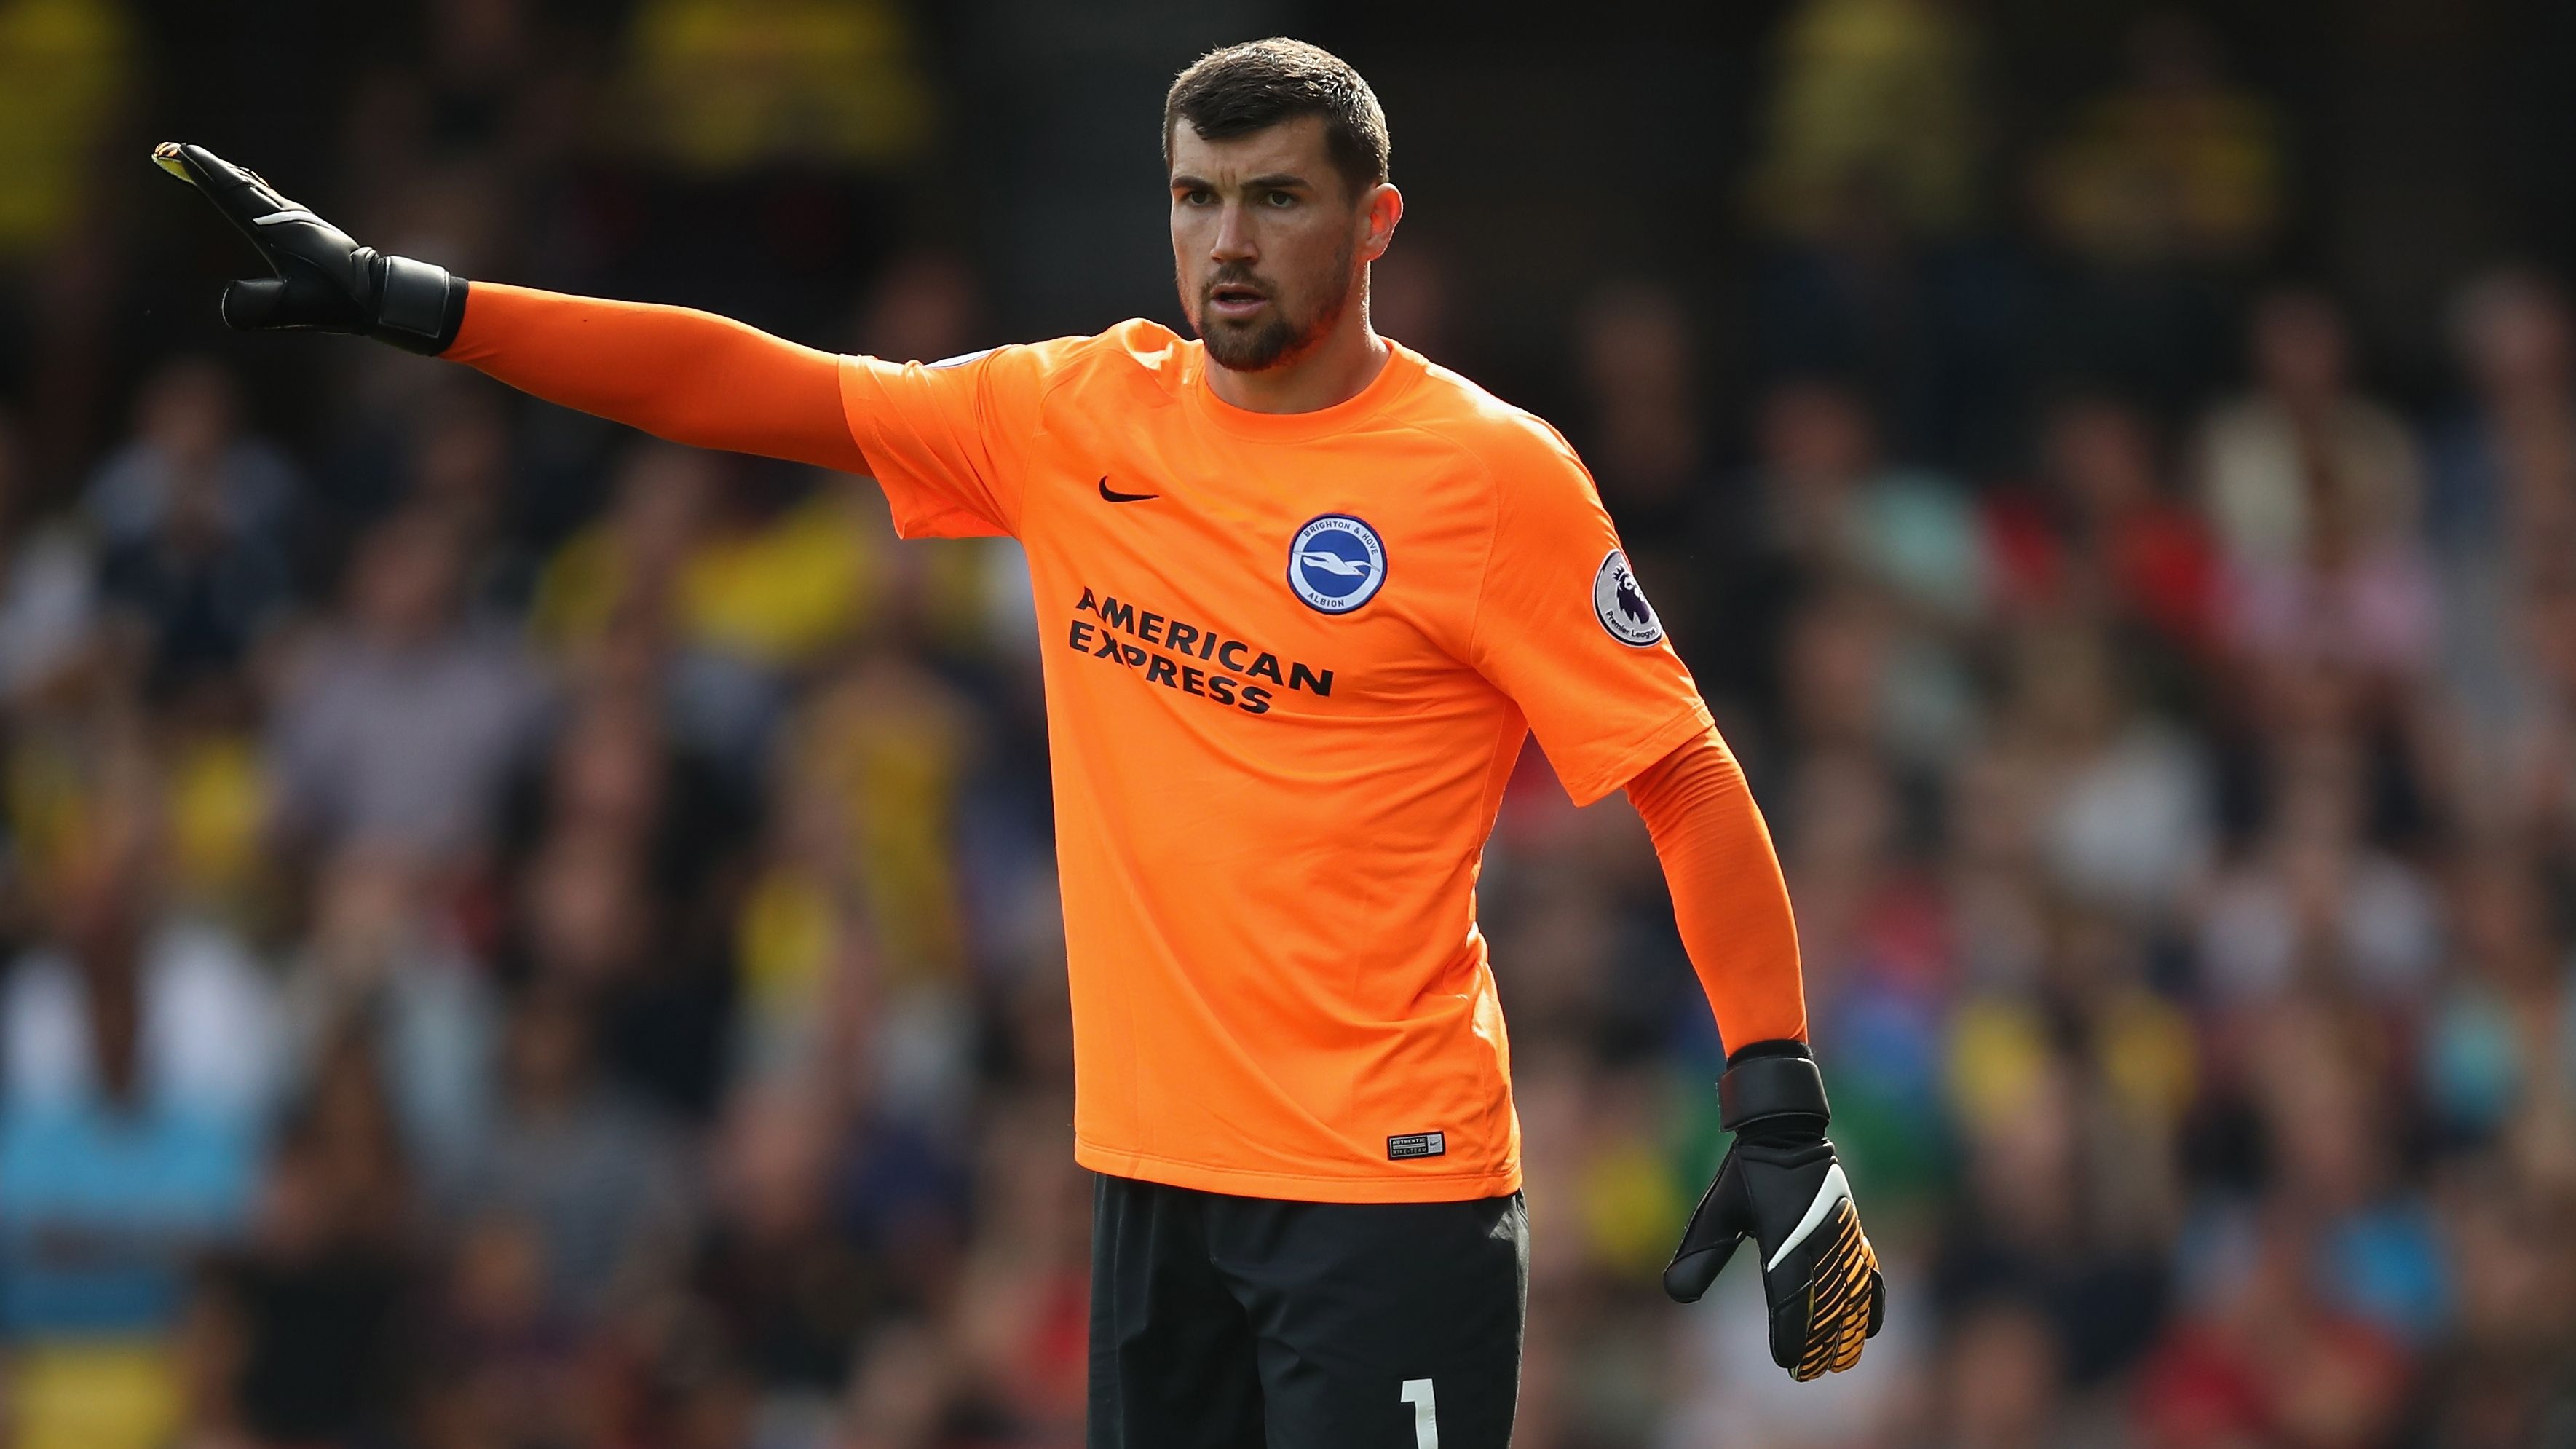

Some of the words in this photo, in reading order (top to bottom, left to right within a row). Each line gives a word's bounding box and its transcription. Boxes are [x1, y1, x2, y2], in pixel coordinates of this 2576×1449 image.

[1303, 521, 1351, 537] BRIGHTON
[1354, 526, 1360, 534] &
[1362, 533, 1378, 555] HOVE
[1307, 592, 1345, 607] ALBION
[1605, 610, 1630, 635] Premier
[1069, 620, 1273, 714] EXPRESS
[1075, 586, 1334, 697] AMERICAN
[1400, 1378, 1439, 1449] 1
